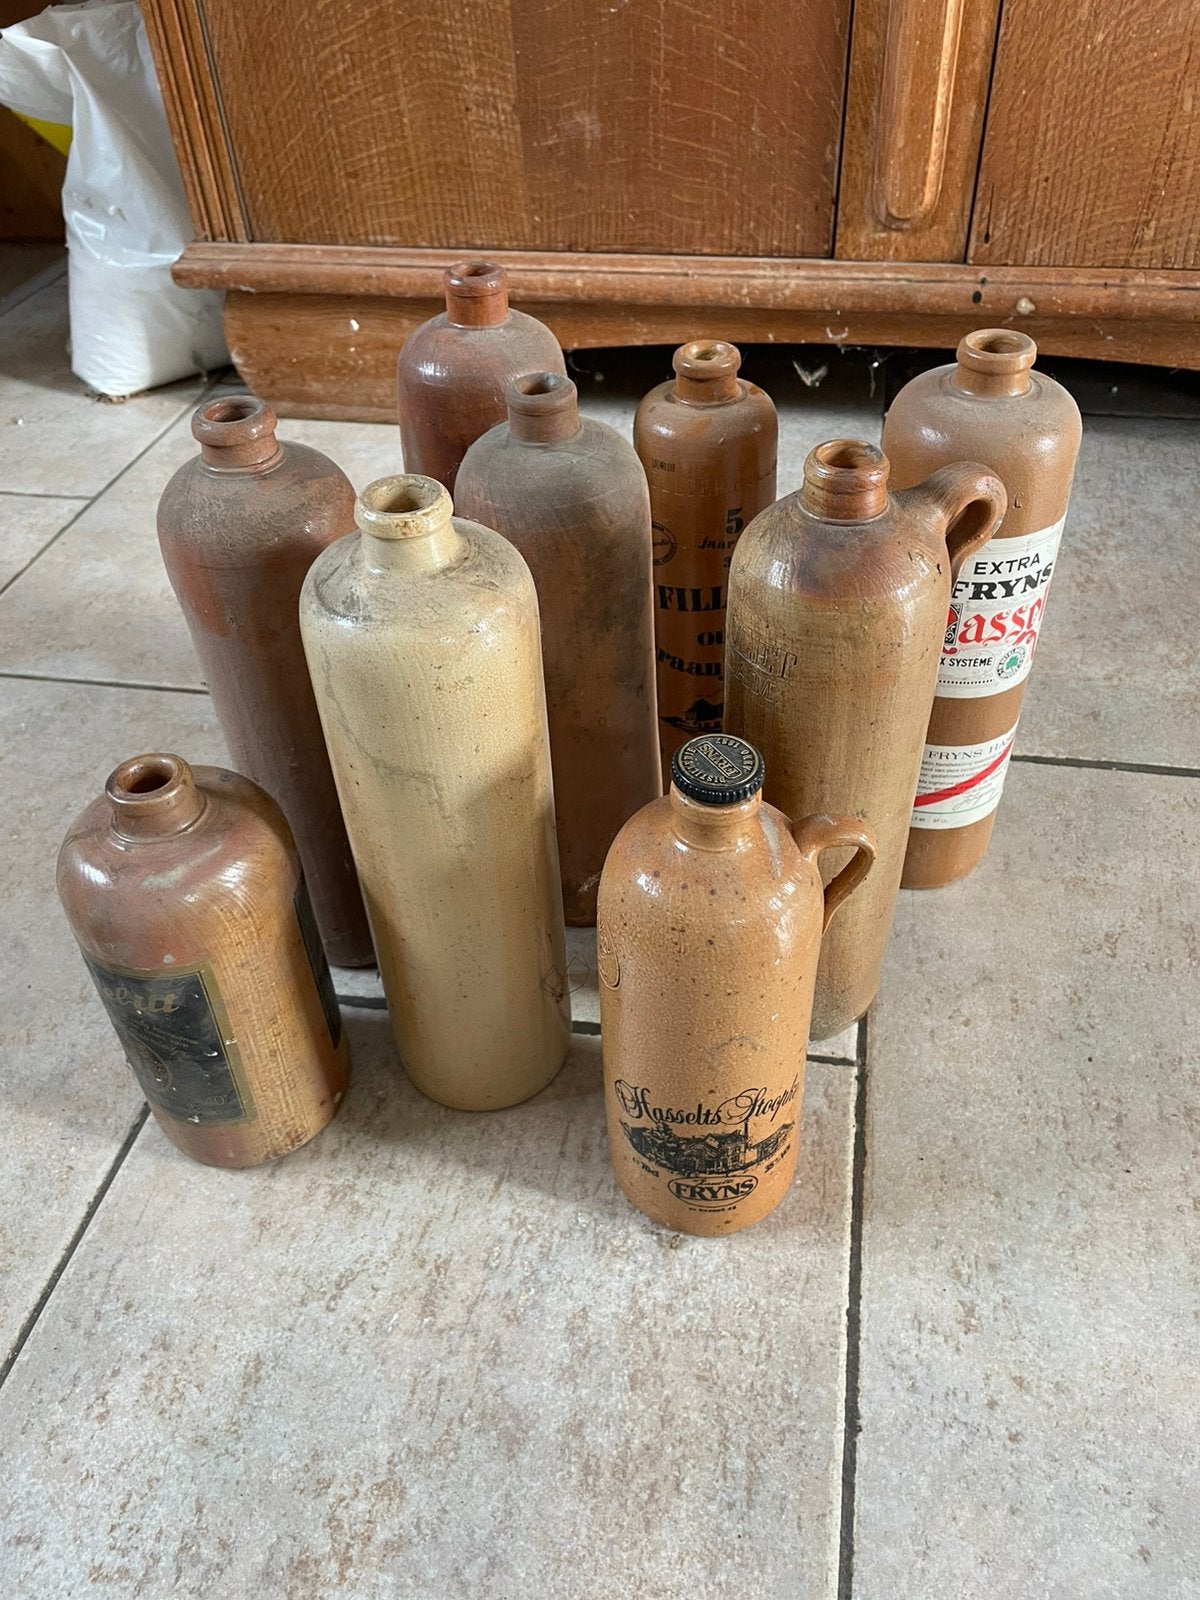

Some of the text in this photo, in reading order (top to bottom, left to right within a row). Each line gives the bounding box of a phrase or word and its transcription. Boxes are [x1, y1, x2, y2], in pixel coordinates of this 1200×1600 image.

[725, 508, 743, 534] 5
[698, 535, 736, 551] jaar
[973, 552, 1041, 575] EXTRA
[952, 560, 1054, 600] FRYNS
[657, 585, 728, 611] FILL
[697, 629, 725, 646] ou
[699, 743, 738, 776] FRYNS
[928, 749, 982, 760] FRYNS
[614, 1079, 722, 1125] Hasselts
[674, 1178, 754, 1201] FRYNS
